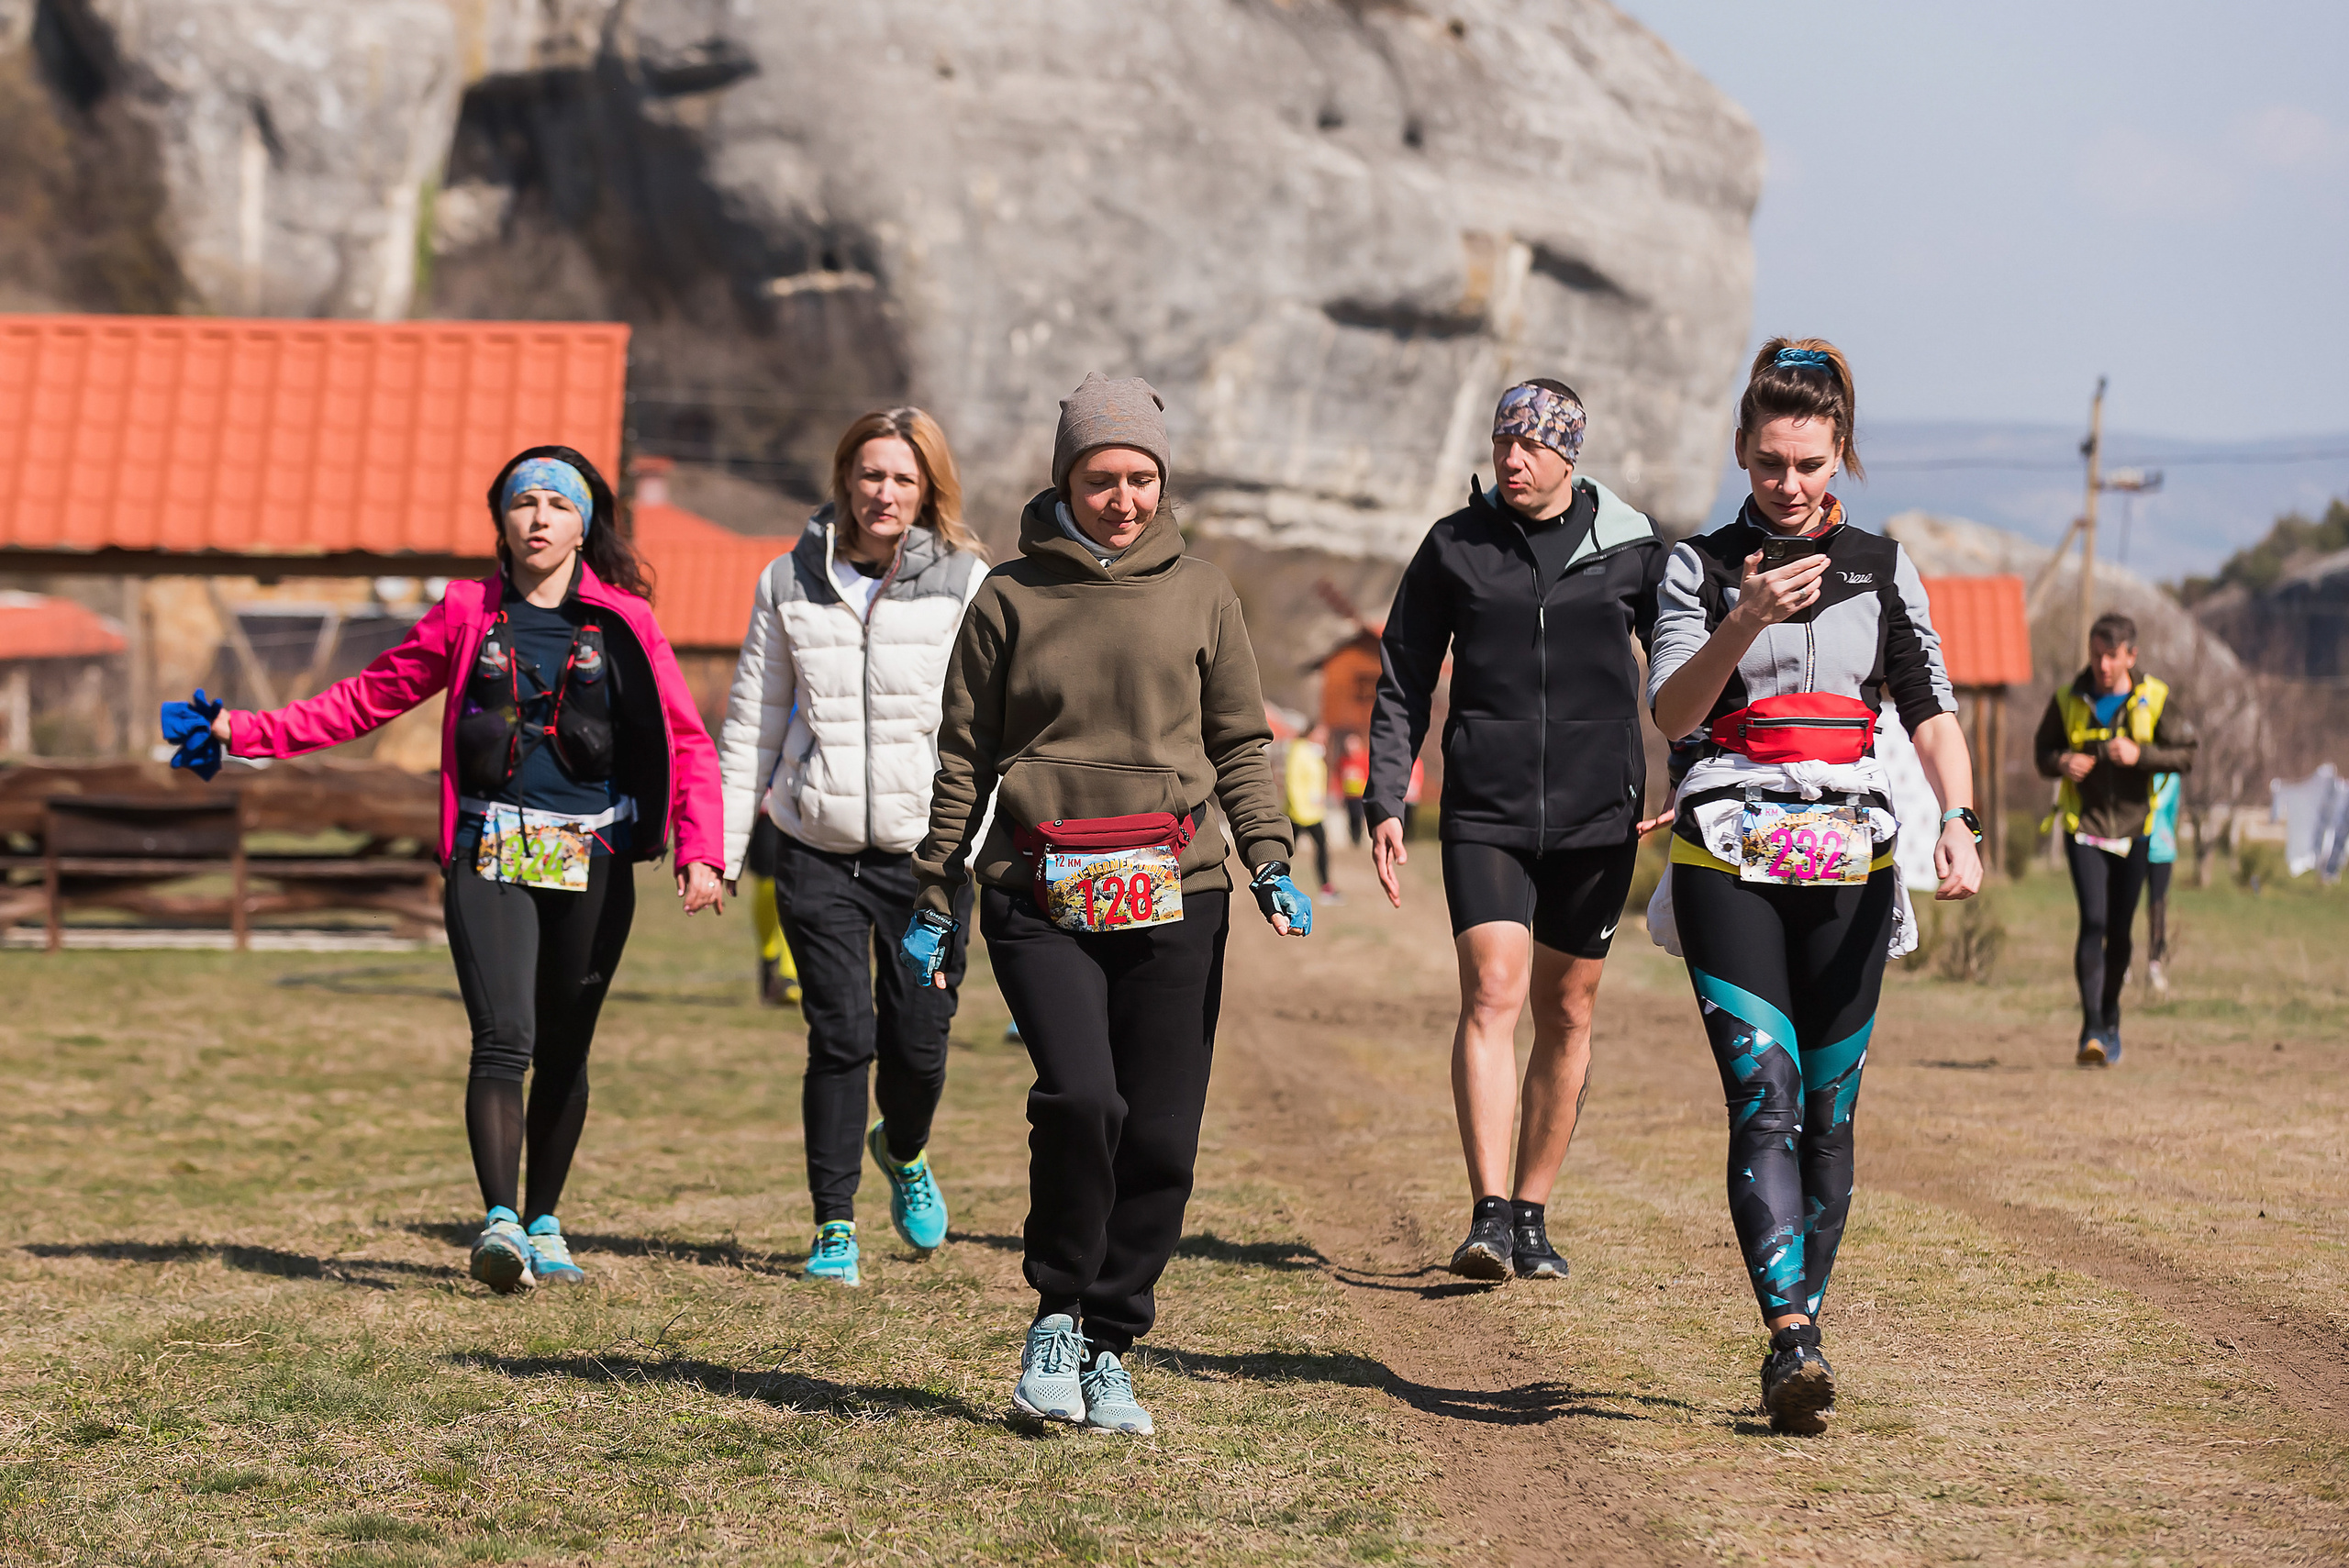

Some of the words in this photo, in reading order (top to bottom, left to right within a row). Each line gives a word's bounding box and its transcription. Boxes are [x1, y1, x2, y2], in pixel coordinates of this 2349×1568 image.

[501, 835, 563, 884] 324
[1054, 854, 1065, 868] 12
[1067, 858, 1082, 868] KM
[1059, 858, 1134, 890] ESKI-KERMEN
[1768, 828, 1843, 880] 232
[1077, 873, 1153, 926] 128
